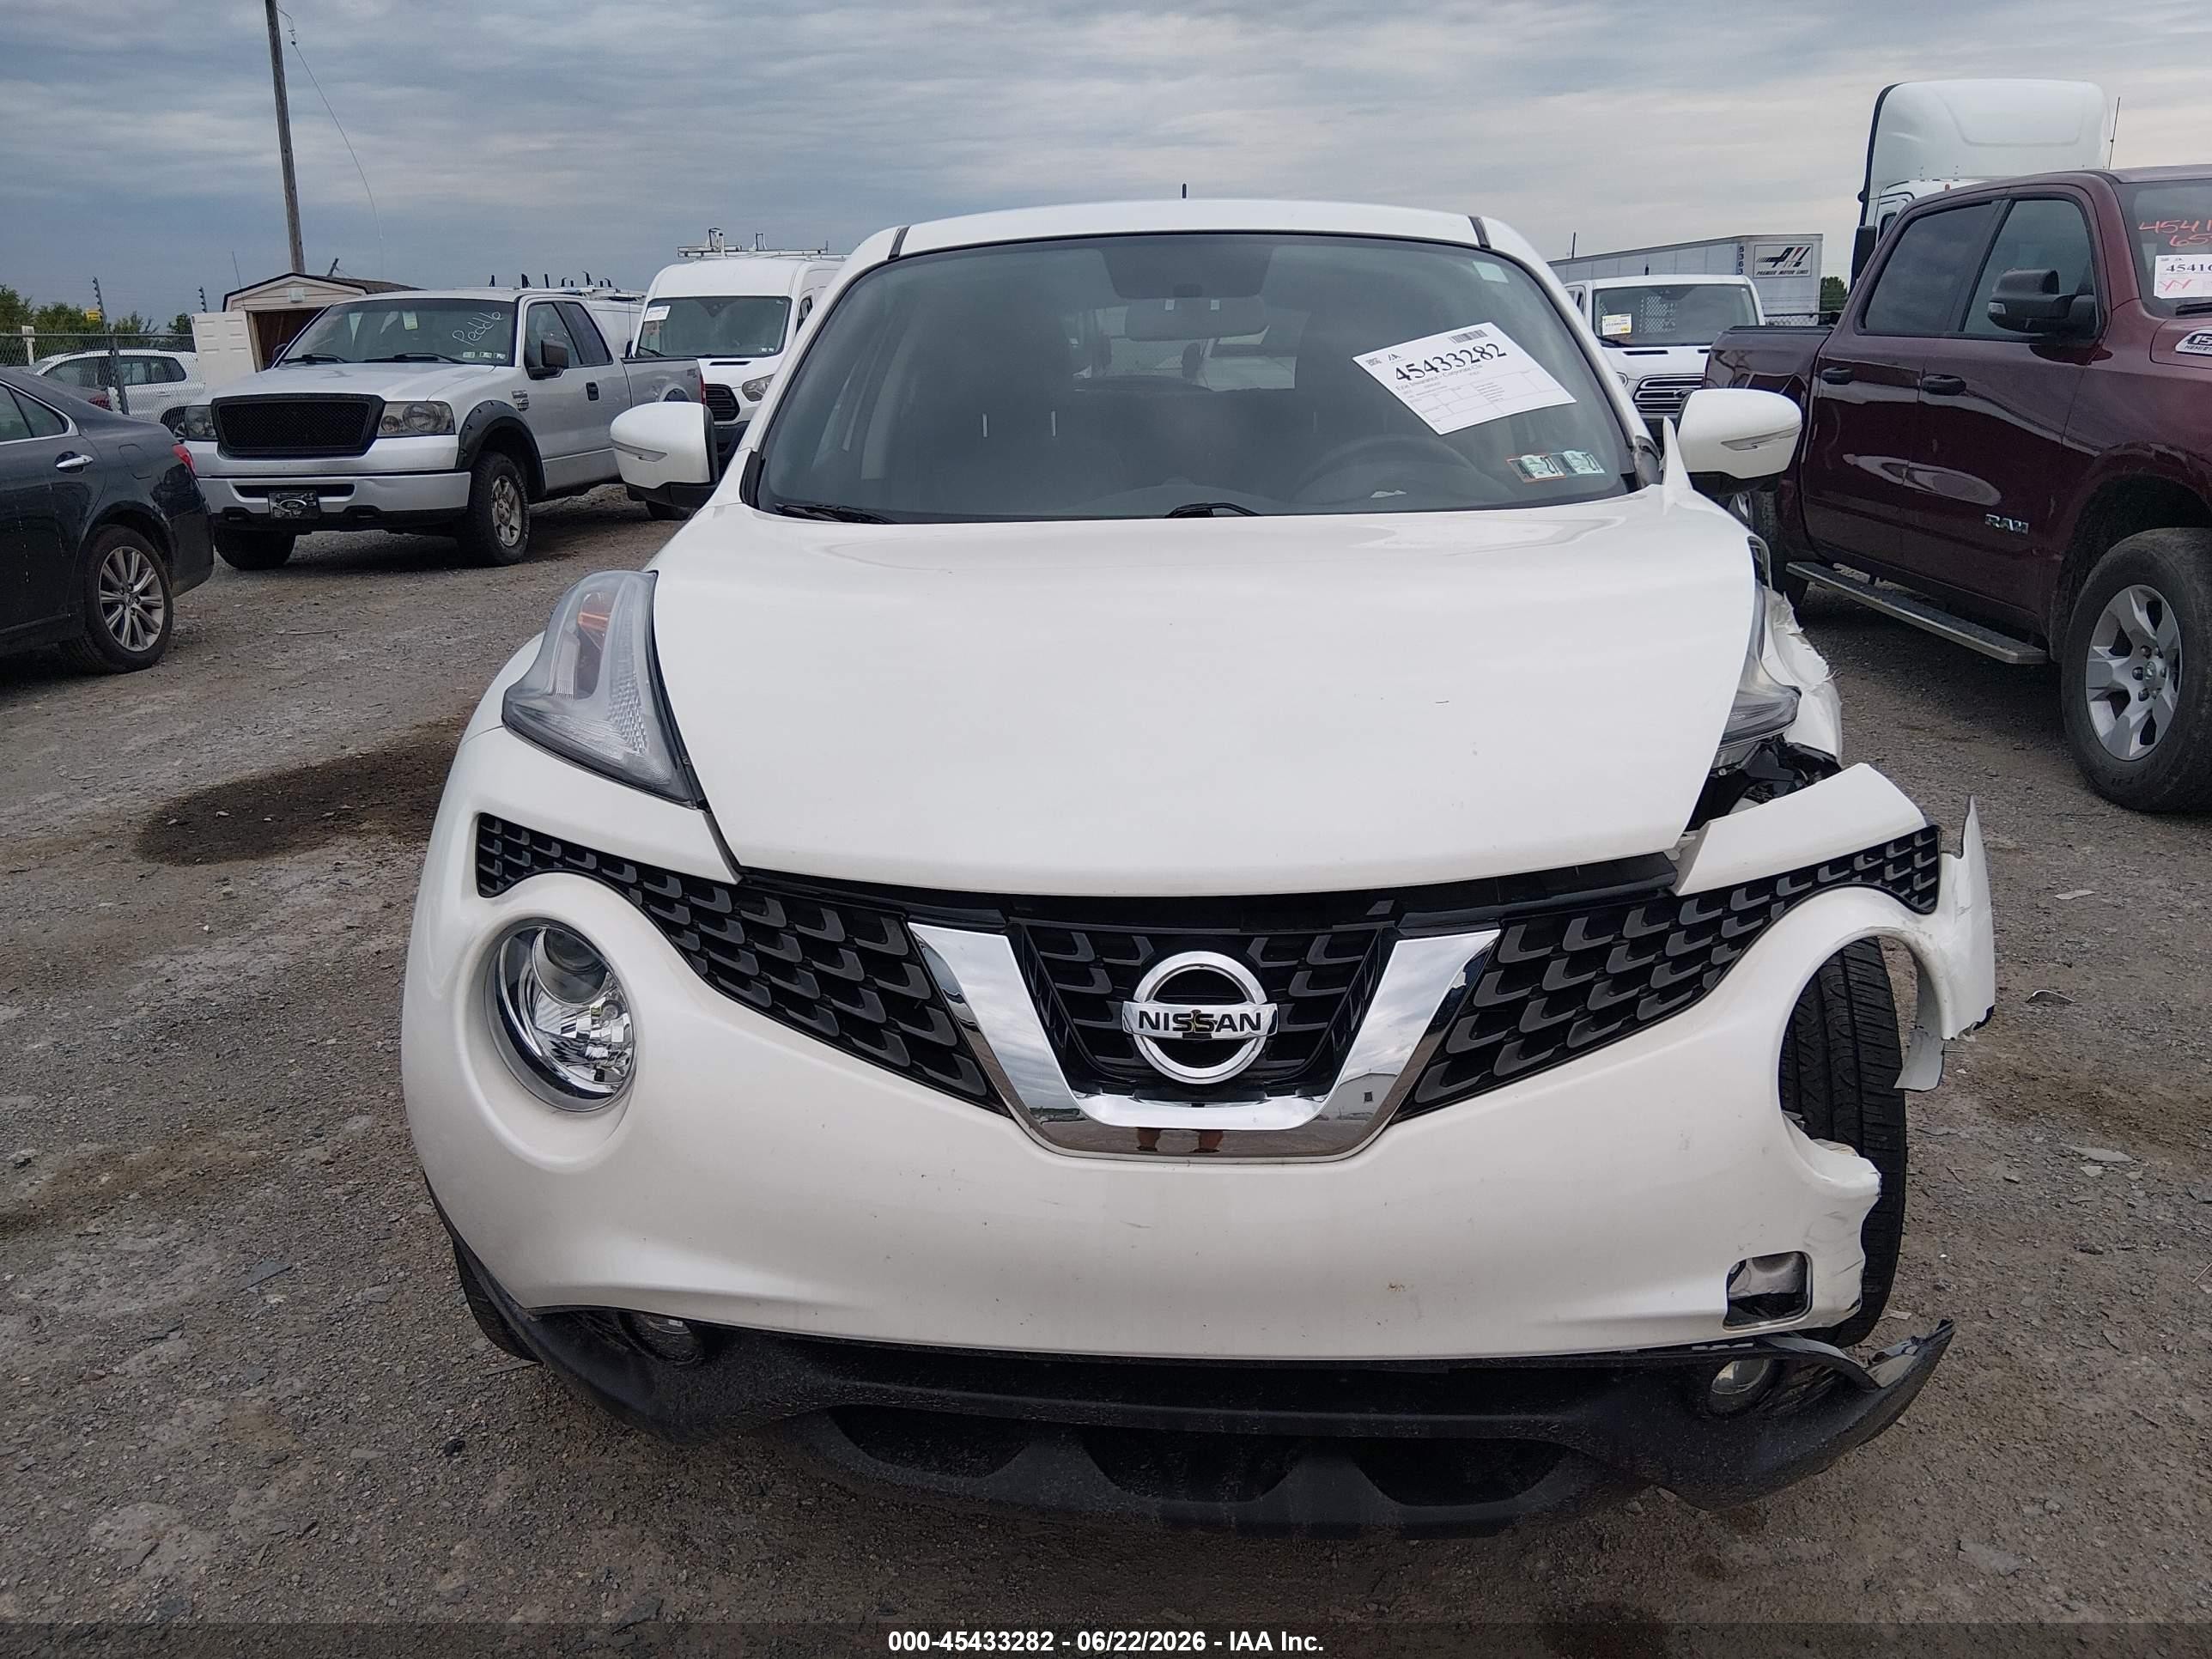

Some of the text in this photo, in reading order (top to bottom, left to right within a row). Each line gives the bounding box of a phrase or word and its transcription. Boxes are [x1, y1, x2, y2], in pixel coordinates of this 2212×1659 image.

[452, 311, 505, 347] Peddle
[1395, 343, 1508, 380] 45433282
[1984, 514, 2029, 535] RAM
[1139, 1010, 1261, 1033] NISSAN
